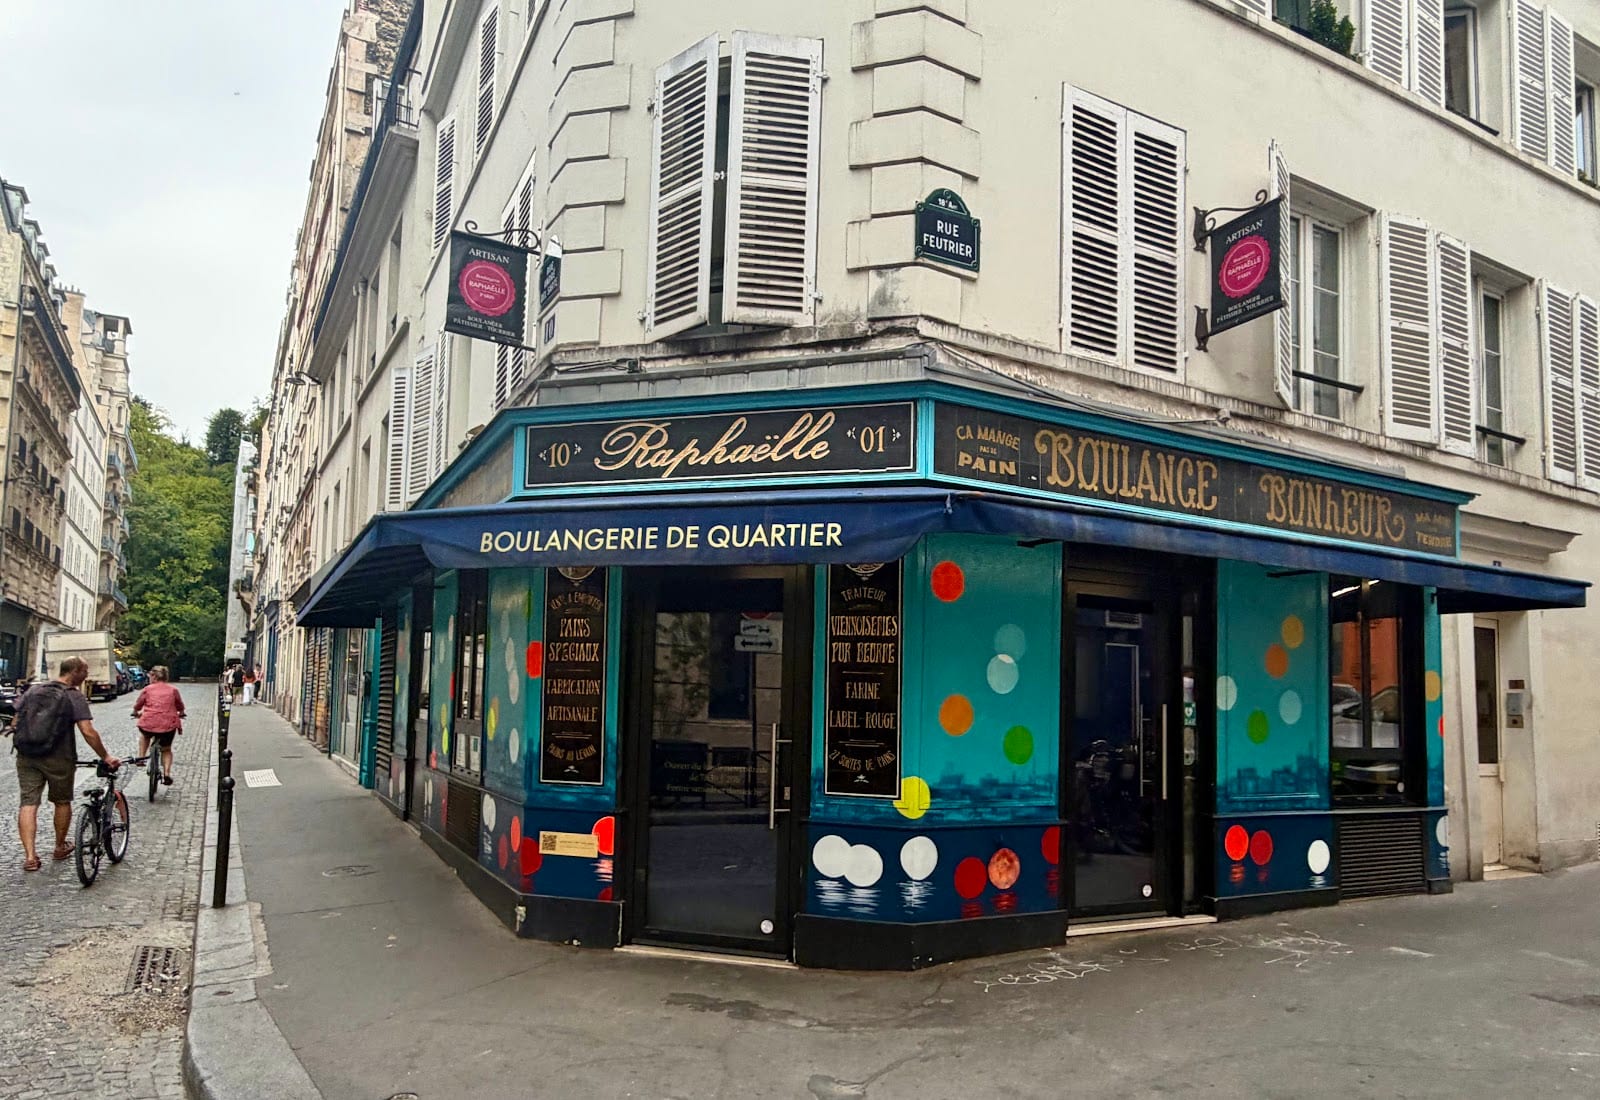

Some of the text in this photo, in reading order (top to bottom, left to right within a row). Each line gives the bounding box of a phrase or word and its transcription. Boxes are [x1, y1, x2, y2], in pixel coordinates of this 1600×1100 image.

[937, 220, 960, 237] RUE
[1225, 219, 1264, 244] ARTISAN
[468, 247, 510, 264] ARTISAN
[923, 233, 973, 258] FEUTRIER
[594, 410, 836, 478] Raphaëlle
[859, 426, 887, 454] 01
[977, 424, 1021, 451] MANGE
[548, 442, 571, 468] 10
[958, 451, 1017, 476] PAIN
[1034, 429, 1218, 511] BOULANGE
[480, 522, 843, 553] BOULANGERIE DE QUARTIER
[841, 586, 887, 602] TRAITEUR
[559, 618, 591, 638] PAINS
[831, 615, 898, 637] VIENNOISERIES
[831, 642, 896, 664] PUR BEURRE
[546, 679, 601, 696] FABRICATION
[845, 682, 881, 700] FARINE
[547, 705, 599, 722] ARTISANALE
